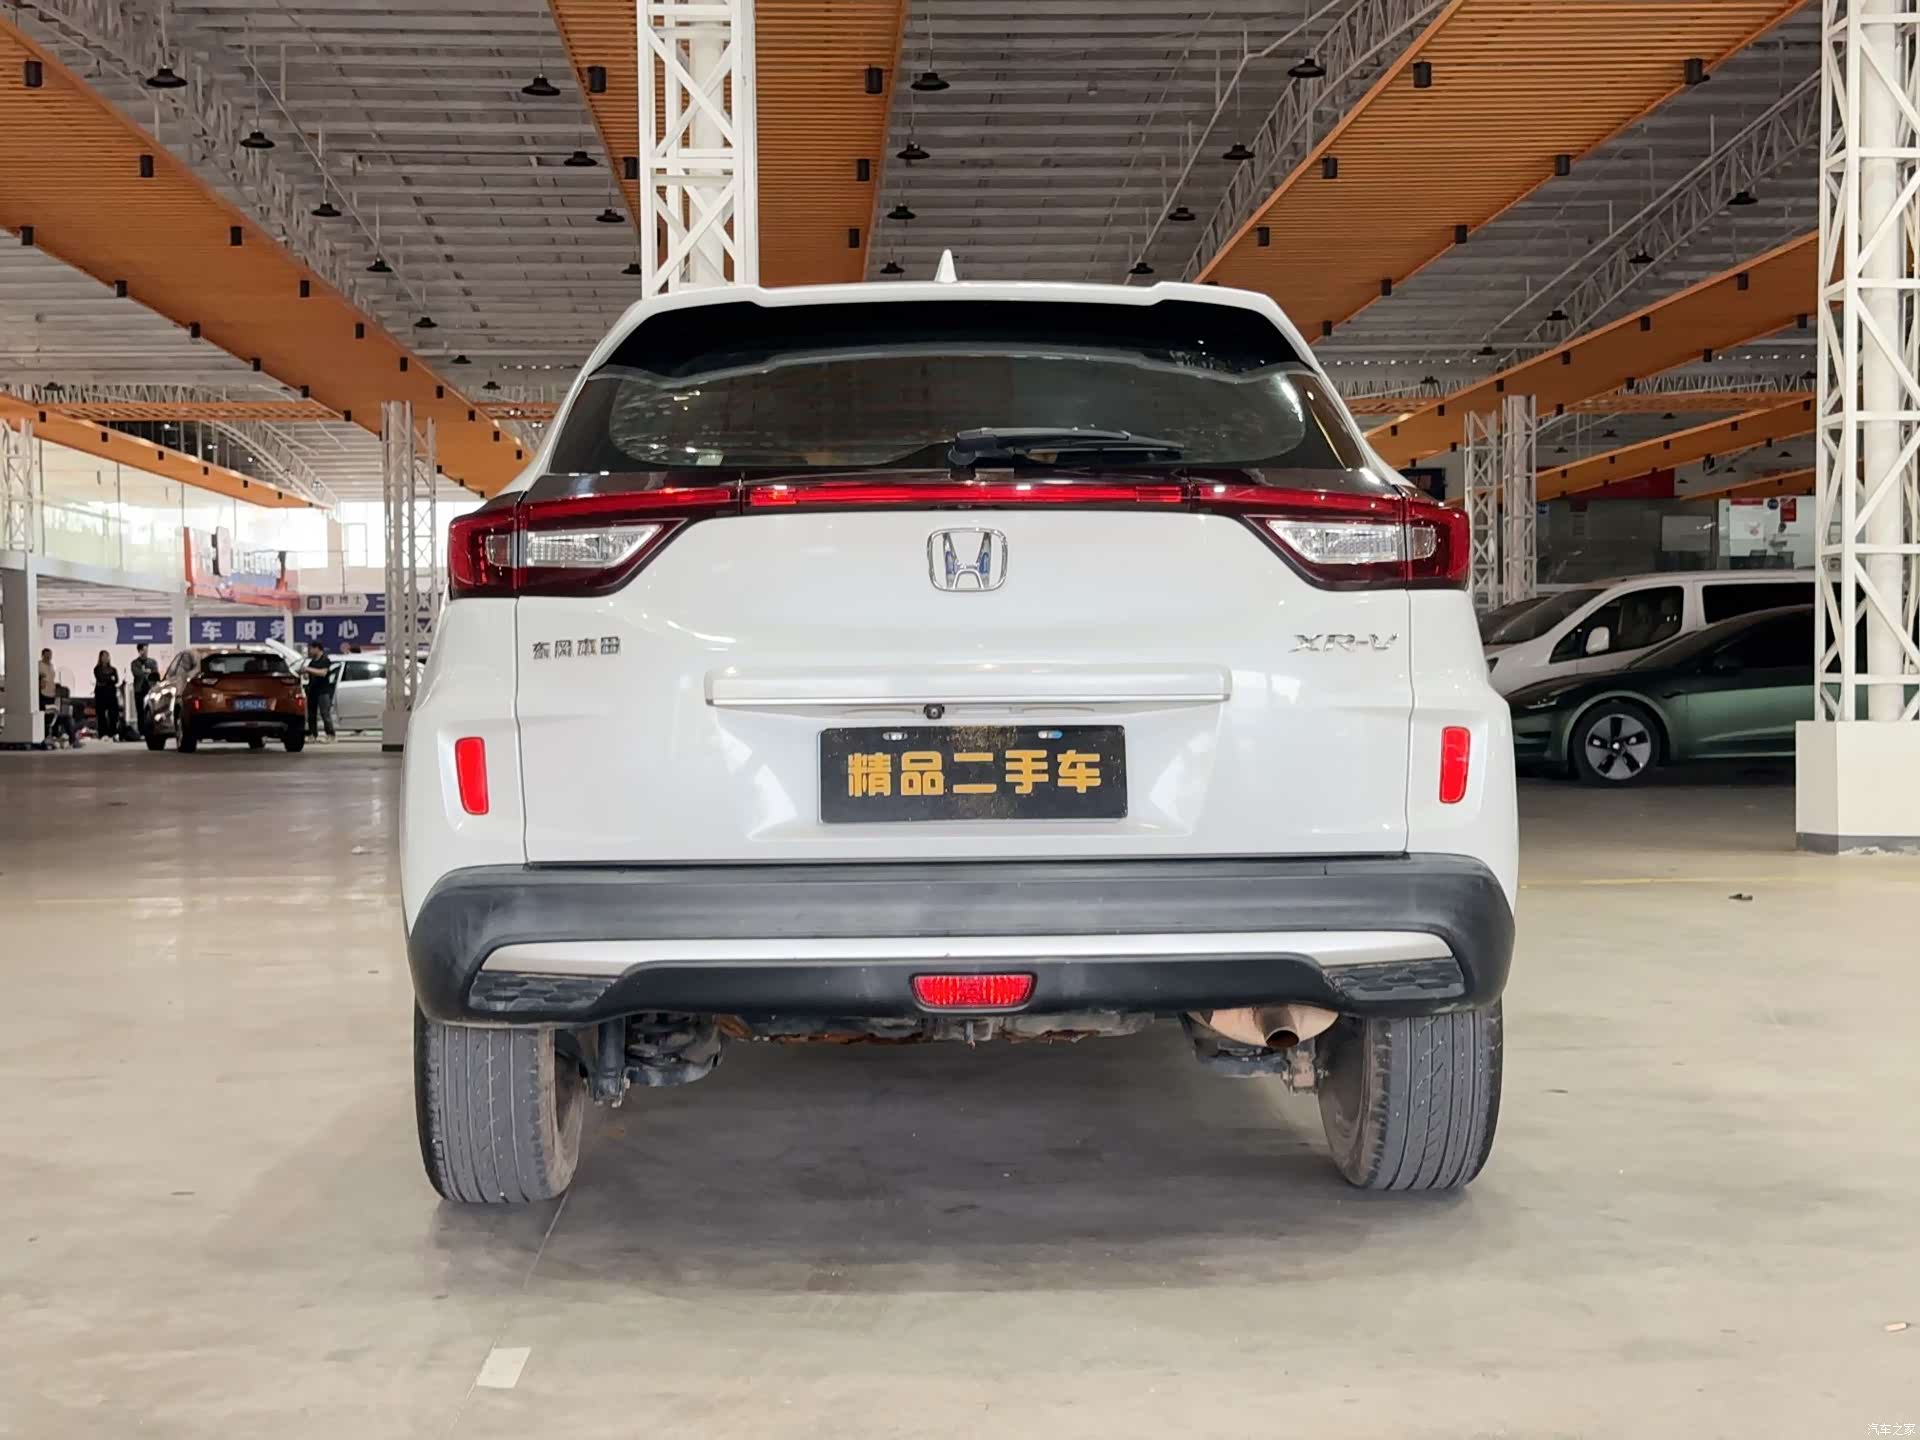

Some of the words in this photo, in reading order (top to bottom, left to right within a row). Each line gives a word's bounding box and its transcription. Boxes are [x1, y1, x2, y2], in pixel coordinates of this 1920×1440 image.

[532, 636, 621, 660] 东风本田
[1288, 633, 1399, 653] XR-V
[848, 750, 1101, 797] 精品二手车
